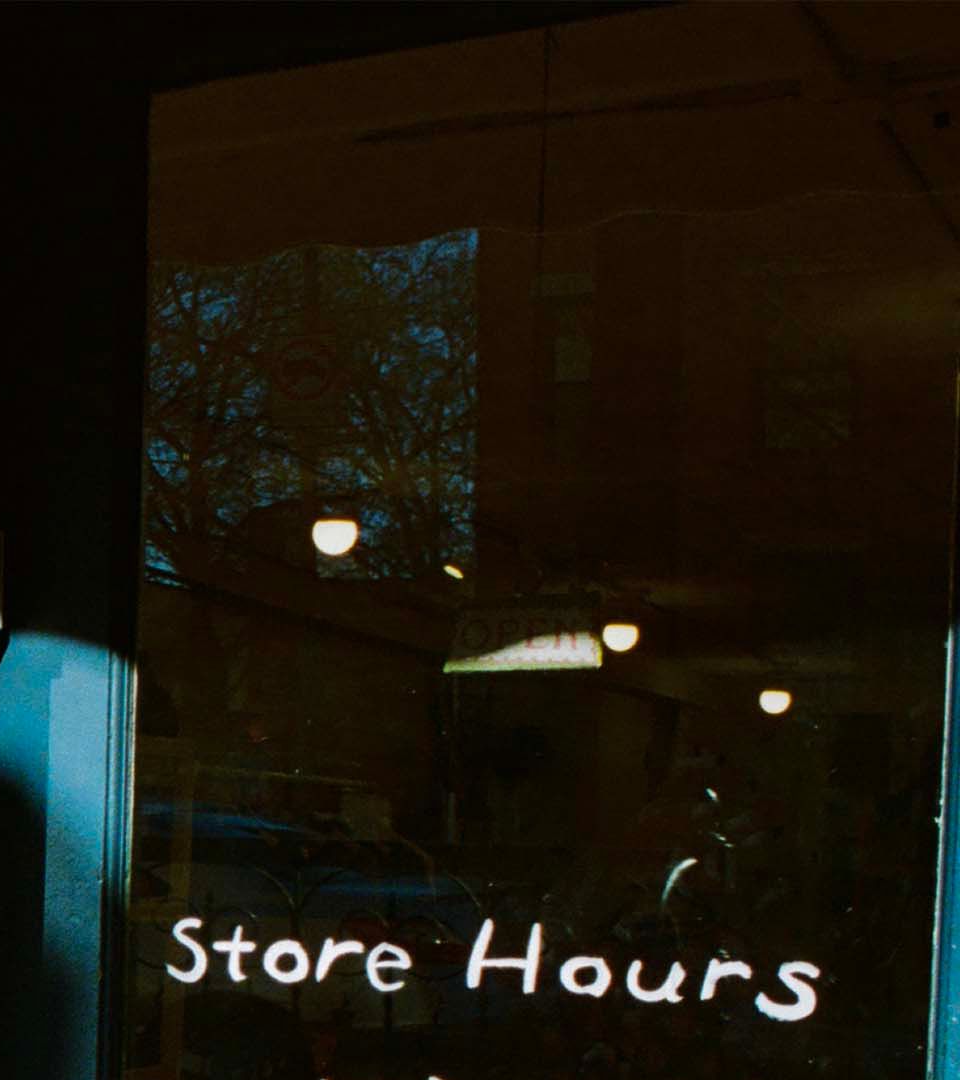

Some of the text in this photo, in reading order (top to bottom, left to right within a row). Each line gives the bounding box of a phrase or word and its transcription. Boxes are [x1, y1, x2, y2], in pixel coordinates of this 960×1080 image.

[462, 617, 578, 650] OPEN
[166, 917, 820, 1022] Store Hours
